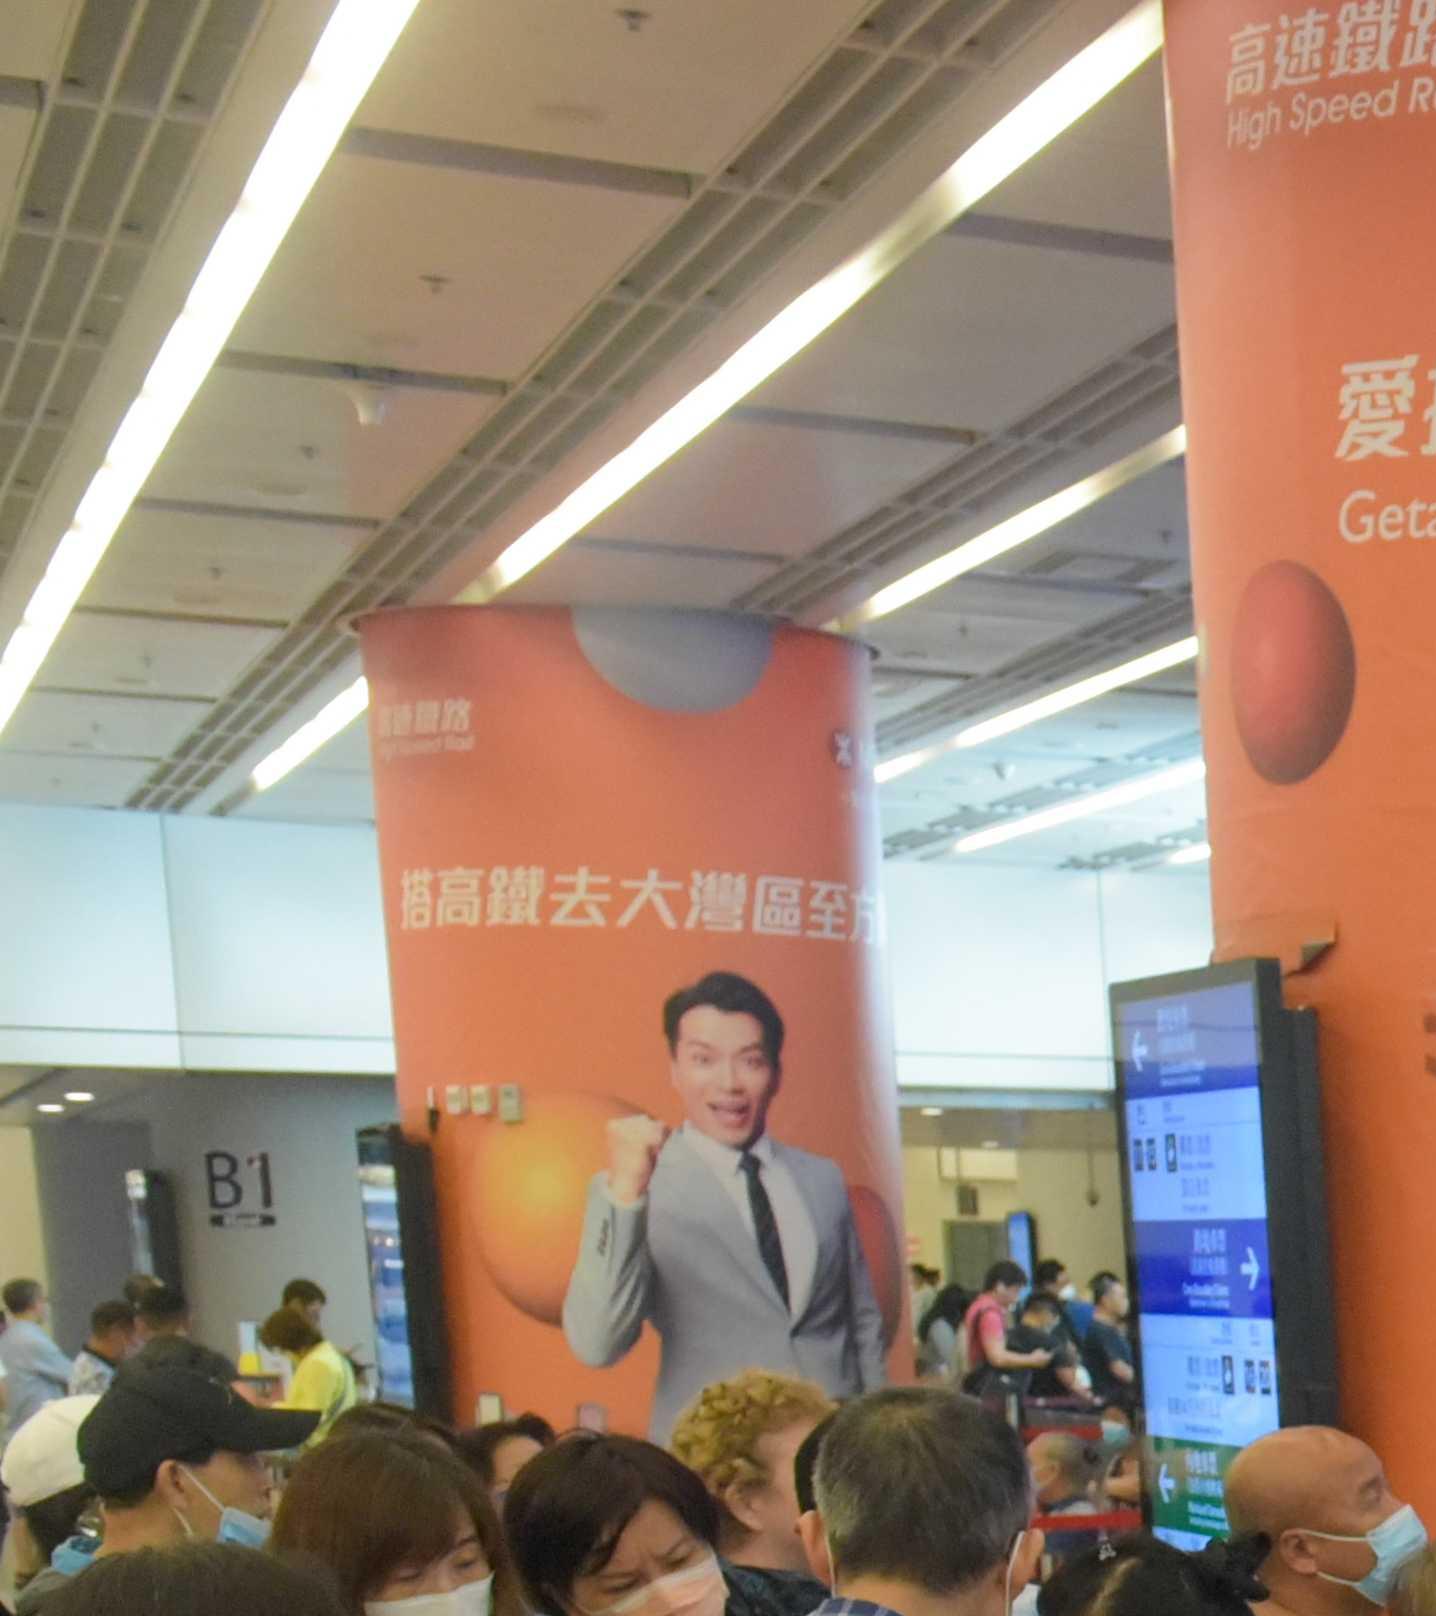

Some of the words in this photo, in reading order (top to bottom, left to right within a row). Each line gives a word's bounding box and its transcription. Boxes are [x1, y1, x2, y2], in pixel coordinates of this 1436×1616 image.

[1227, 102, 1282, 150] High
[1289, 79, 1400, 137] Speed
[205, 1152, 273, 1210] B1
